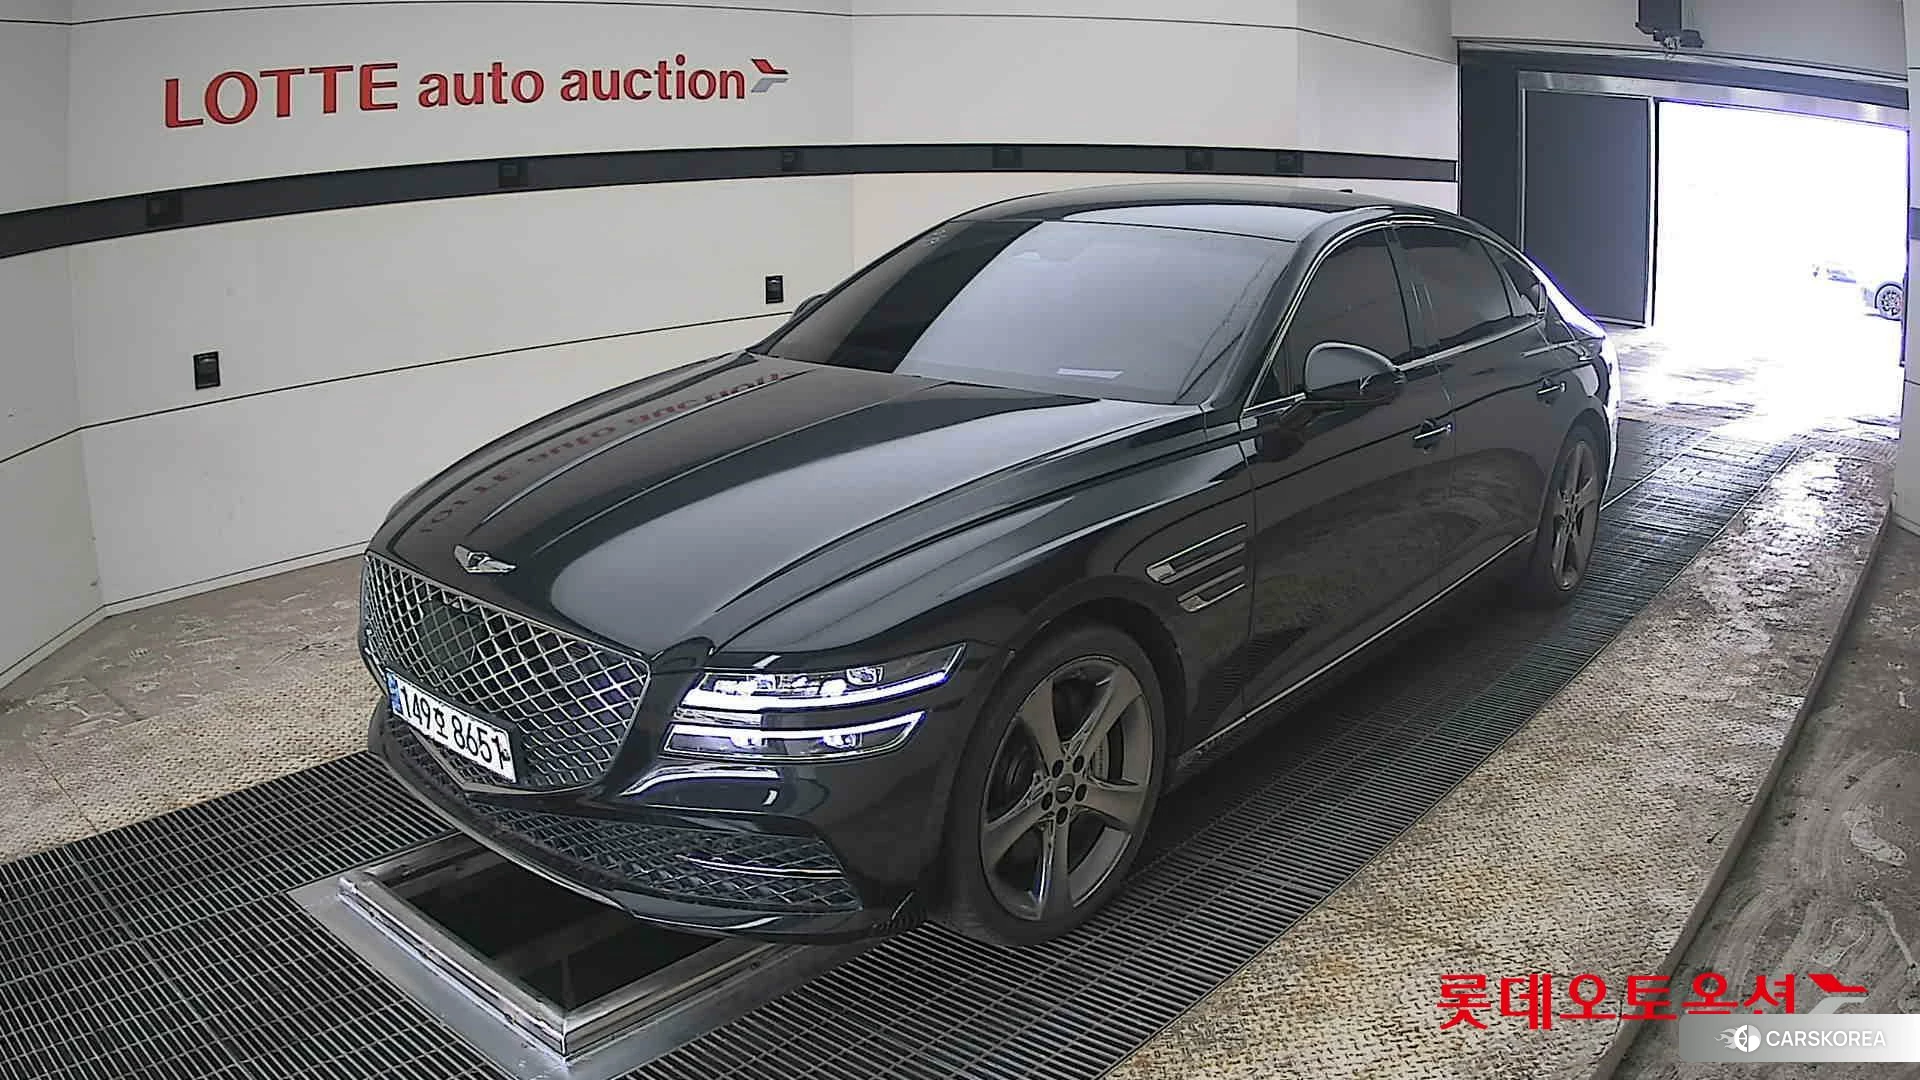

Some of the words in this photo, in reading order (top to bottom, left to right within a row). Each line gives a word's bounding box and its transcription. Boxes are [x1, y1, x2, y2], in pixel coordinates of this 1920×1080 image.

[164, 62, 400, 129] LOTTE
[417, 61, 545, 108] auto
[559, 53, 746, 102] auction
[451, 714, 505, 770] 8651
